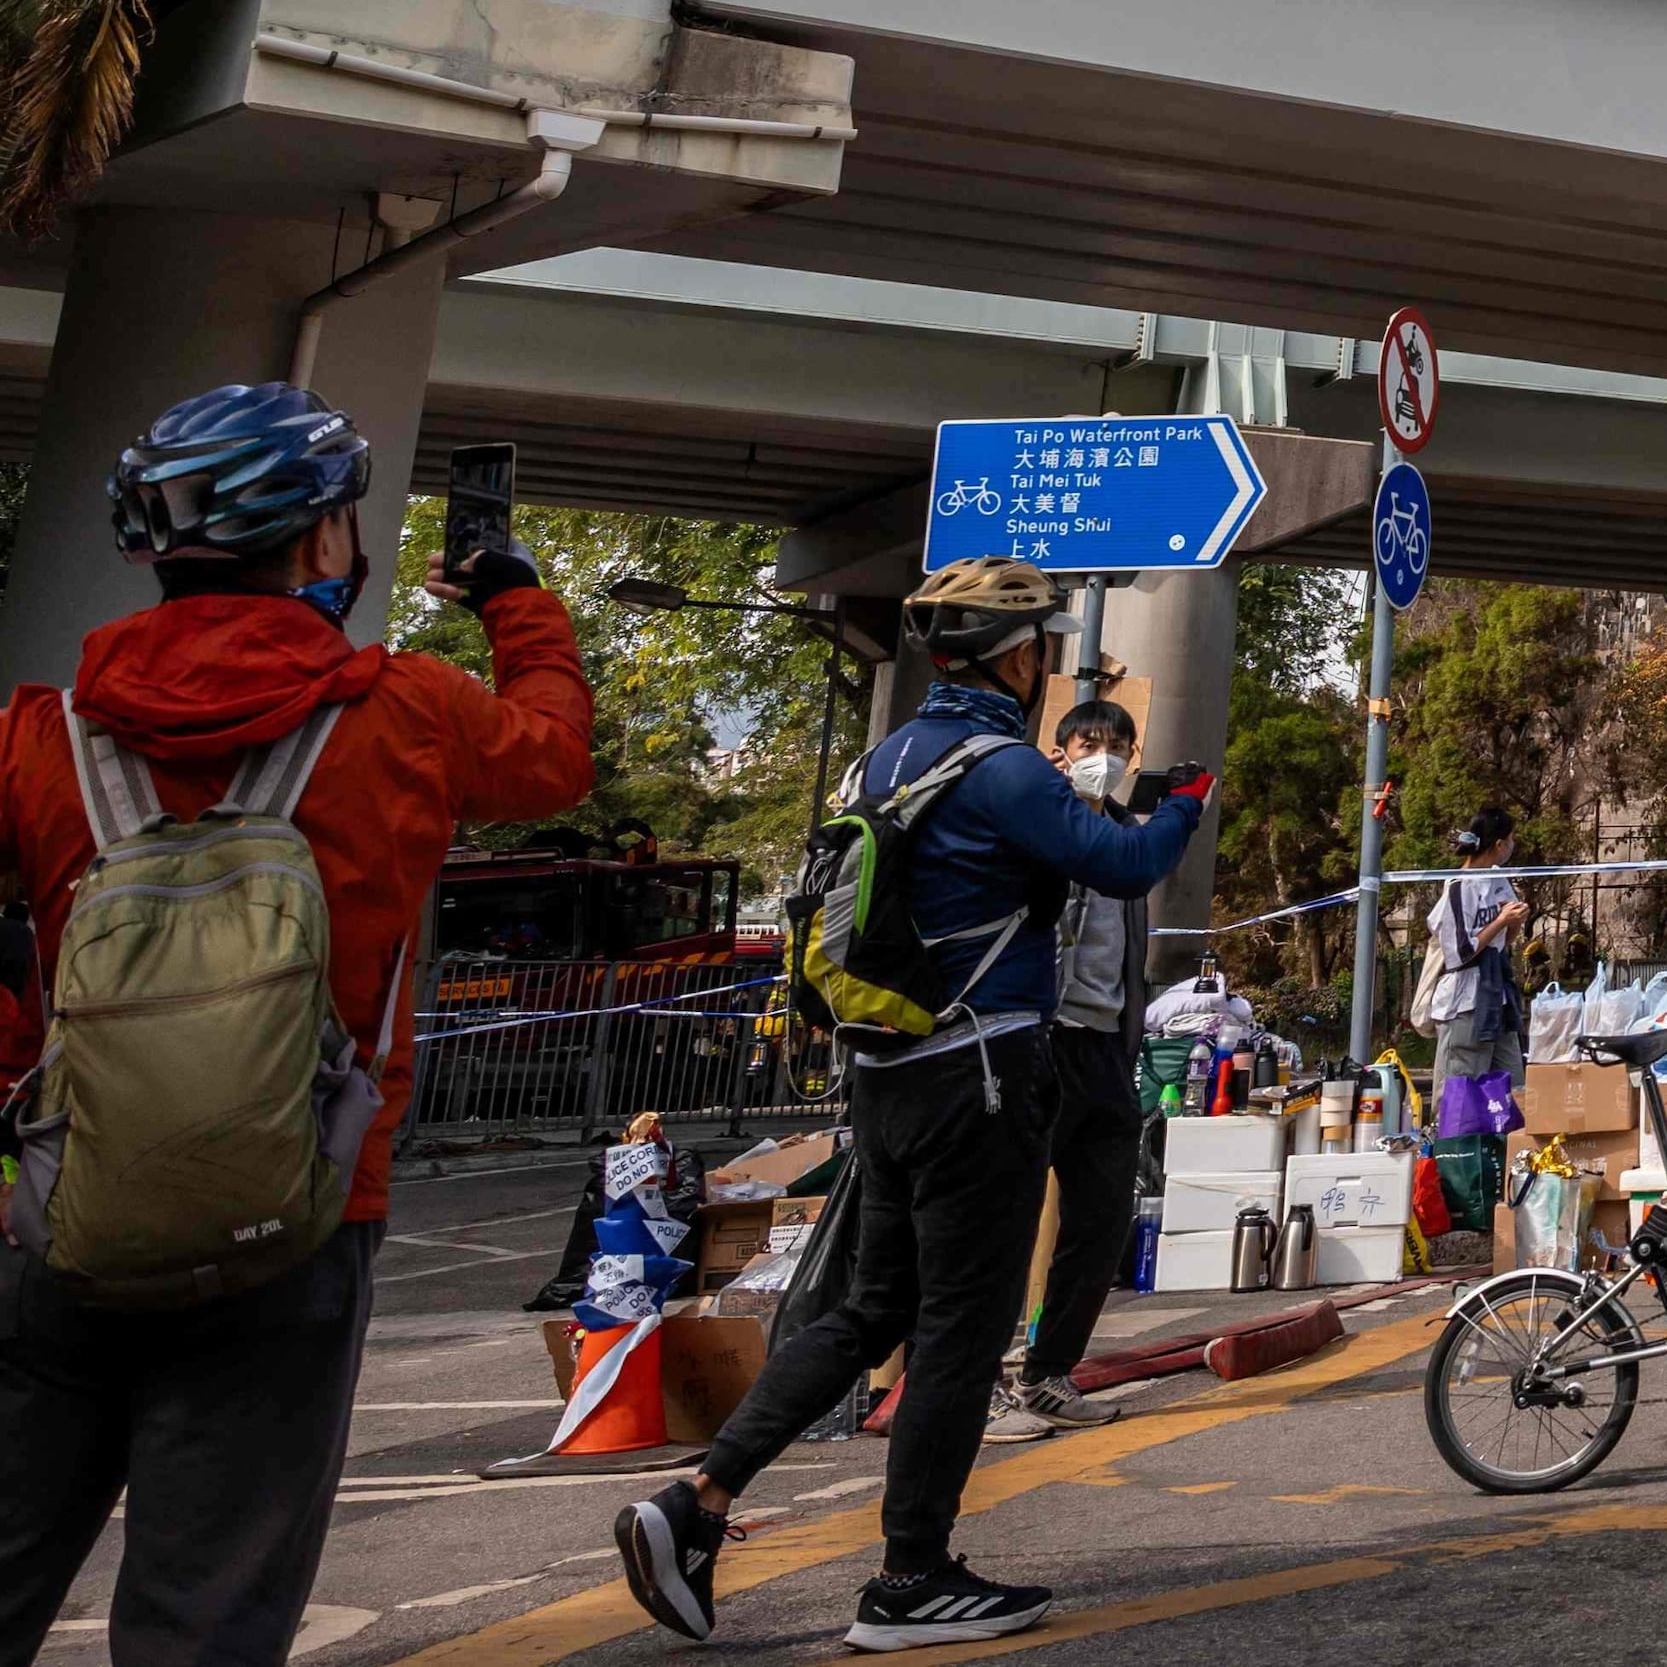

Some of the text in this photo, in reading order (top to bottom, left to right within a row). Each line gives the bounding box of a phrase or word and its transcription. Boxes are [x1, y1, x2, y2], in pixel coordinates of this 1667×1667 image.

[1015, 426, 1203, 444] Tai Po Waterfront Park
[1013, 446, 1159, 469] 大埔海濱公園
[1010, 473, 1102, 488] Tai Mei Tuk
[1009, 492, 1081, 514] 大美督
[1006, 517, 1111, 535] Sheung Shui
[1010, 538, 1050, 559] 上水
[607, 1160, 629, 1185] LICE
[615, 1160, 655, 1191] DO NOT
[233, 1219, 284, 1241] DAY 20L
